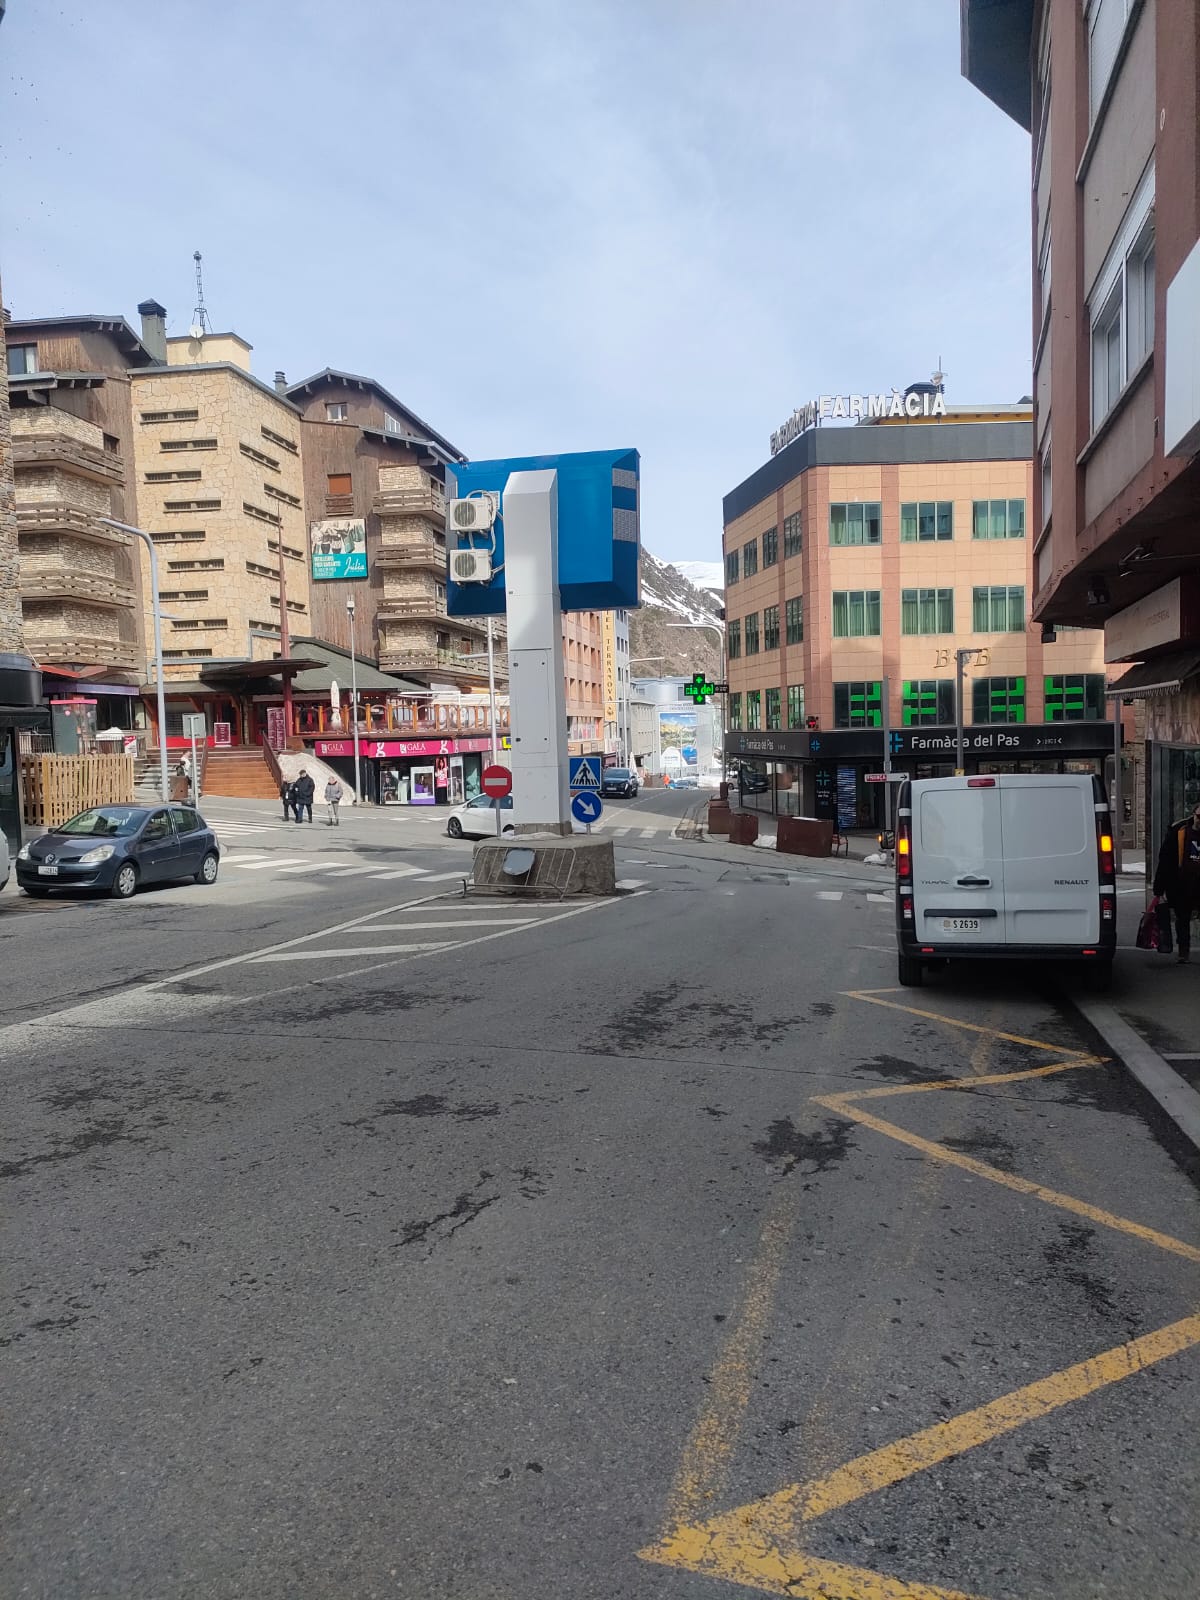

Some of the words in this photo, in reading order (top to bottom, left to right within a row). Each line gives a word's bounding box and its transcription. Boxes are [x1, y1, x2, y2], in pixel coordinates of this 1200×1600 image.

[819, 387, 947, 418] FARMÀCIA
[700, 683, 714, 695] del
[911, 735, 970, 749] Farmàca
[973, 734, 993, 748] del
[997, 733, 1020, 747] Pas
[327, 743, 344, 751] GALA
[406, 743, 426, 751] GALA
[953, 920, 958, 929] S
[959, 920, 979, 929] 2639
